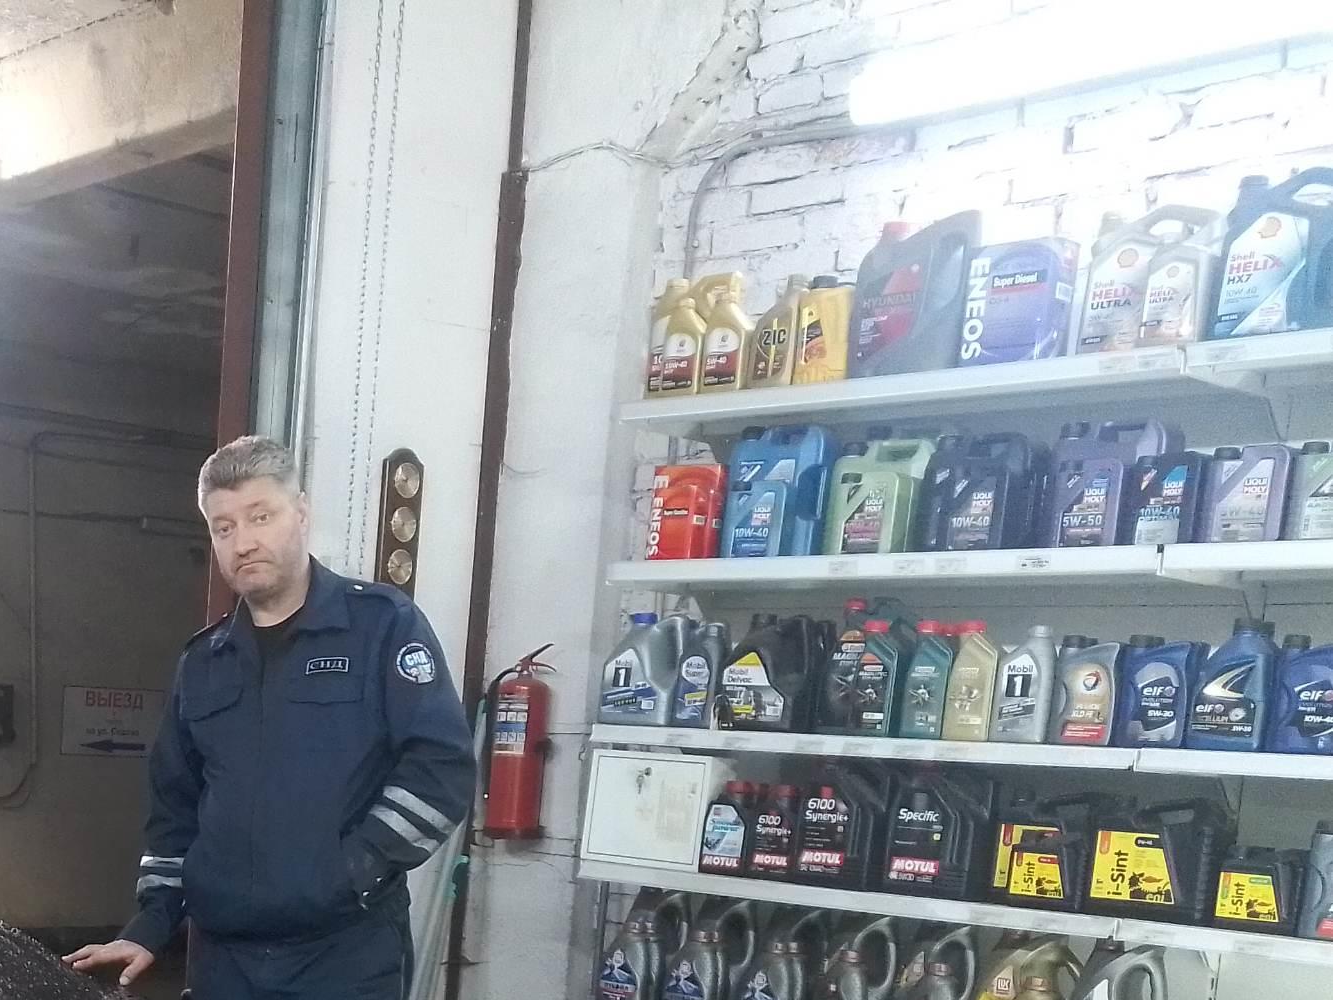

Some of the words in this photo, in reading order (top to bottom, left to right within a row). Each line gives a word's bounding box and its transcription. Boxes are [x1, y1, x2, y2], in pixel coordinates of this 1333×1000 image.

[1227, 273, 1253, 285] HX7
[961, 257, 991, 360] ENEOS
[1091, 298, 1132, 310] ULTRA
[762, 328, 787, 346] ZIC
[647, 496, 664, 558] ENEOS
[951, 516, 990, 529] 10W-40
[1062, 514, 1103, 528] 5W-50
[685, 661, 707, 671] Mobil
[728, 667, 749, 676] Mobil
[1008, 664, 1034, 673] Mobil
[1142, 686, 1165, 696] elf
[1299, 690, 1325, 701] elf
[85, 690, 144, 712] ВЫЕЗД
[1195, 703, 1215, 713] elf
[807, 798, 836, 810] 6100
[758, 814, 781, 825] 6100
[898, 807, 940, 822] Specific
[702, 855, 739, 867] MOTUL
[753, 853, 788, 866] MOTUL
[801, 850, 841, 864] MOTUL
[892, 859, 936, 873] MOTUL
[1107, 849, 1129, 896] i-Sint
[1020, 860, 1036, 893] i-Sint
[1145, 891, 1166, 903] eni
[1229, 881, 1247, 916] i-Sint
